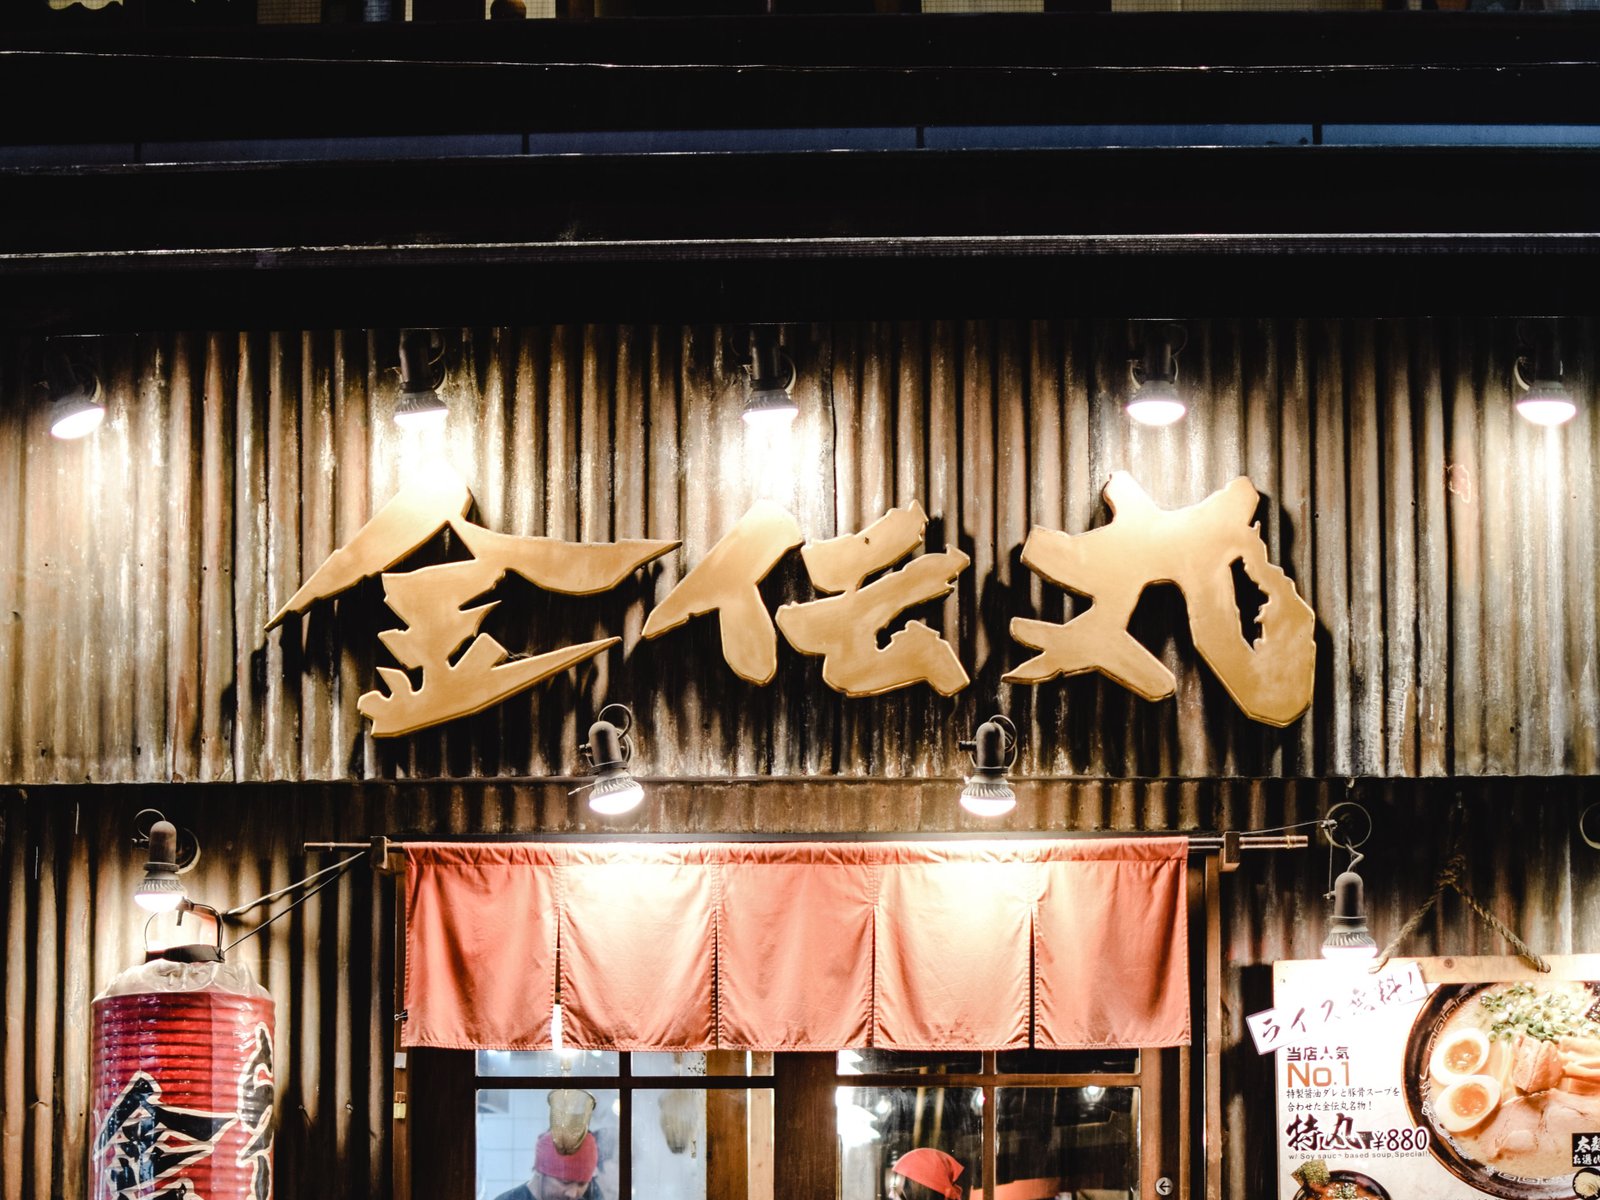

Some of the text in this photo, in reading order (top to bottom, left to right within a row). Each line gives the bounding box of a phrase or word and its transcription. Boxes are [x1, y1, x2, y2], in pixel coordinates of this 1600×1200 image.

[264, 470, 1316, 738] 金伝丸
[1286, 1046, 1350, 1062] 当店人気
[1287, 1062, 1350, 1088] No.1
[1285, 1113, 1428, 1151] 特丸 ¥880
